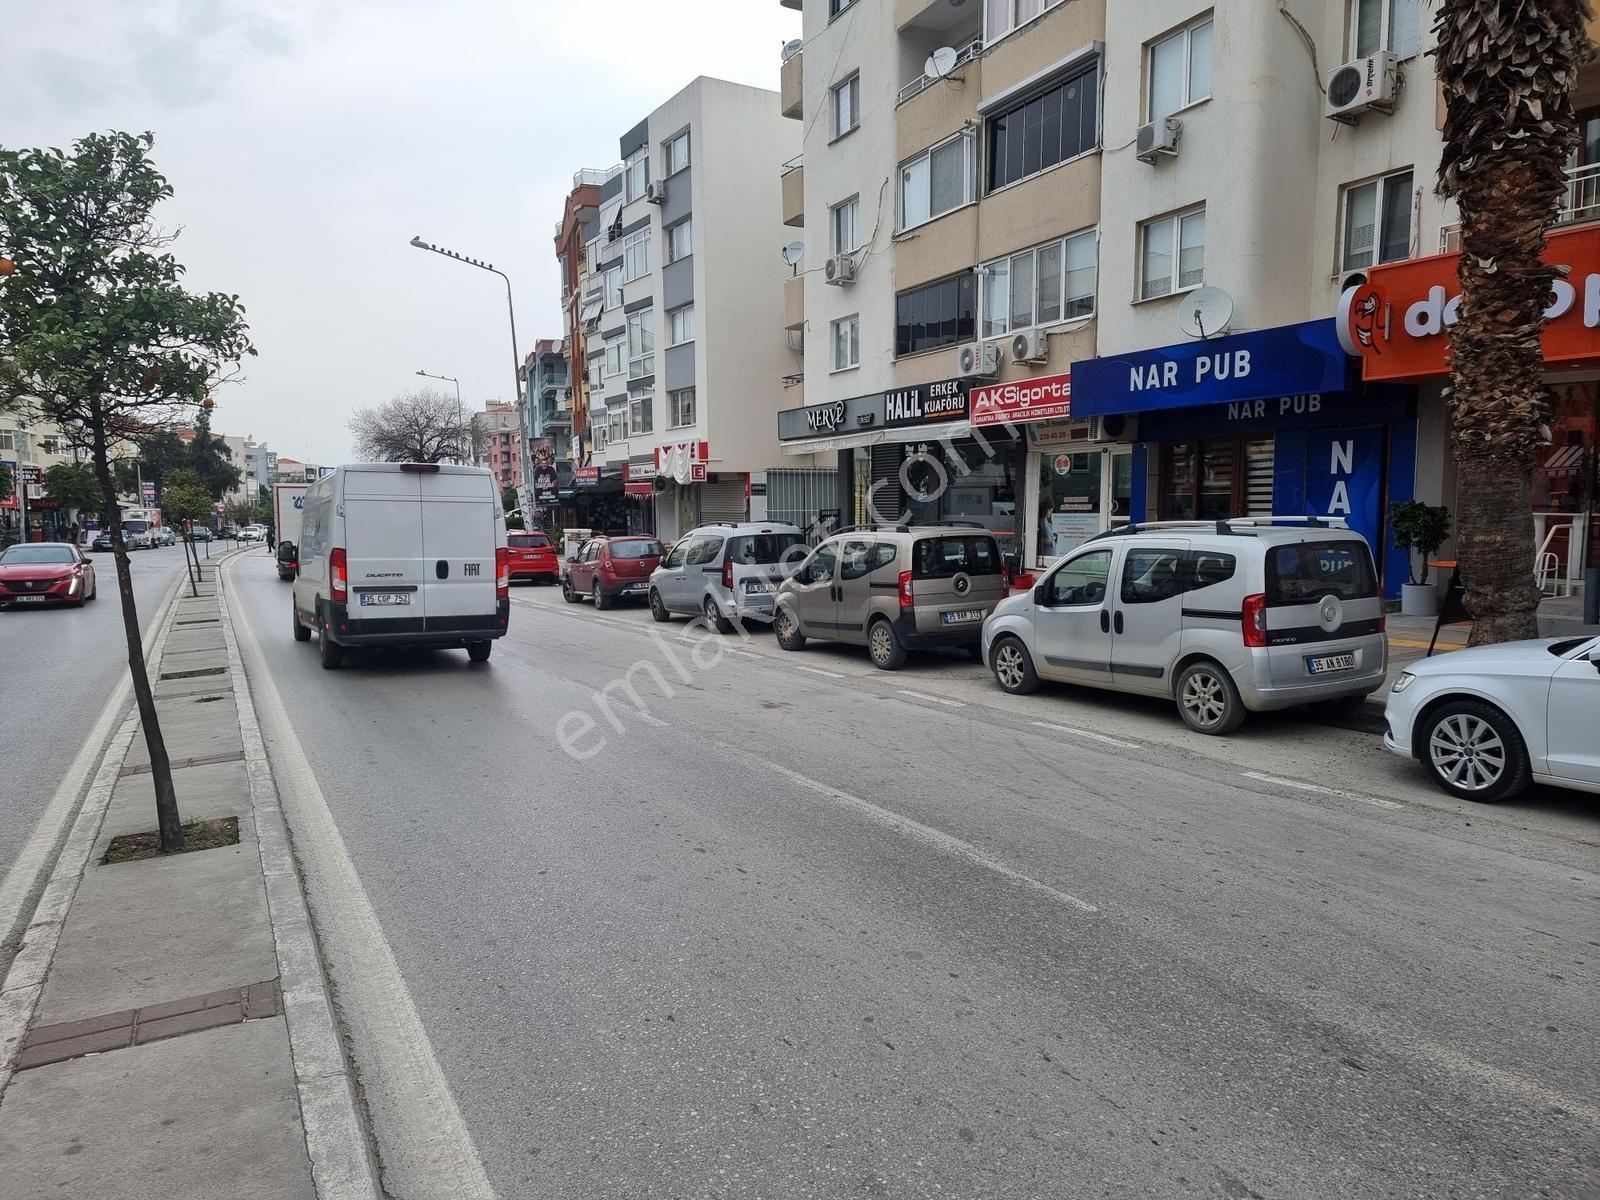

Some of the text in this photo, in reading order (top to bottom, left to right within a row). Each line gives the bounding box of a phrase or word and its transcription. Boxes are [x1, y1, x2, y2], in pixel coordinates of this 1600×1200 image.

[1367, 58, 1375, 87] arçelik
[1129, 350, 1250, 391] NAR PUB
[930, 381, 958, 397] ERKEK
[975, 382, 1071, 407] AKSigorta
[924, 393, 965, 413] KUAFÖRÜ
[1228, 394, 1321, 420] NAR PUB
[806, 401, 845, 431] MERVE
[464, 563, 480, 576] FIAT
[395, 594, 408, 602] 752
[1314, 660, 1323, 671] 35
[1326, 658, 1336, 669] AN
